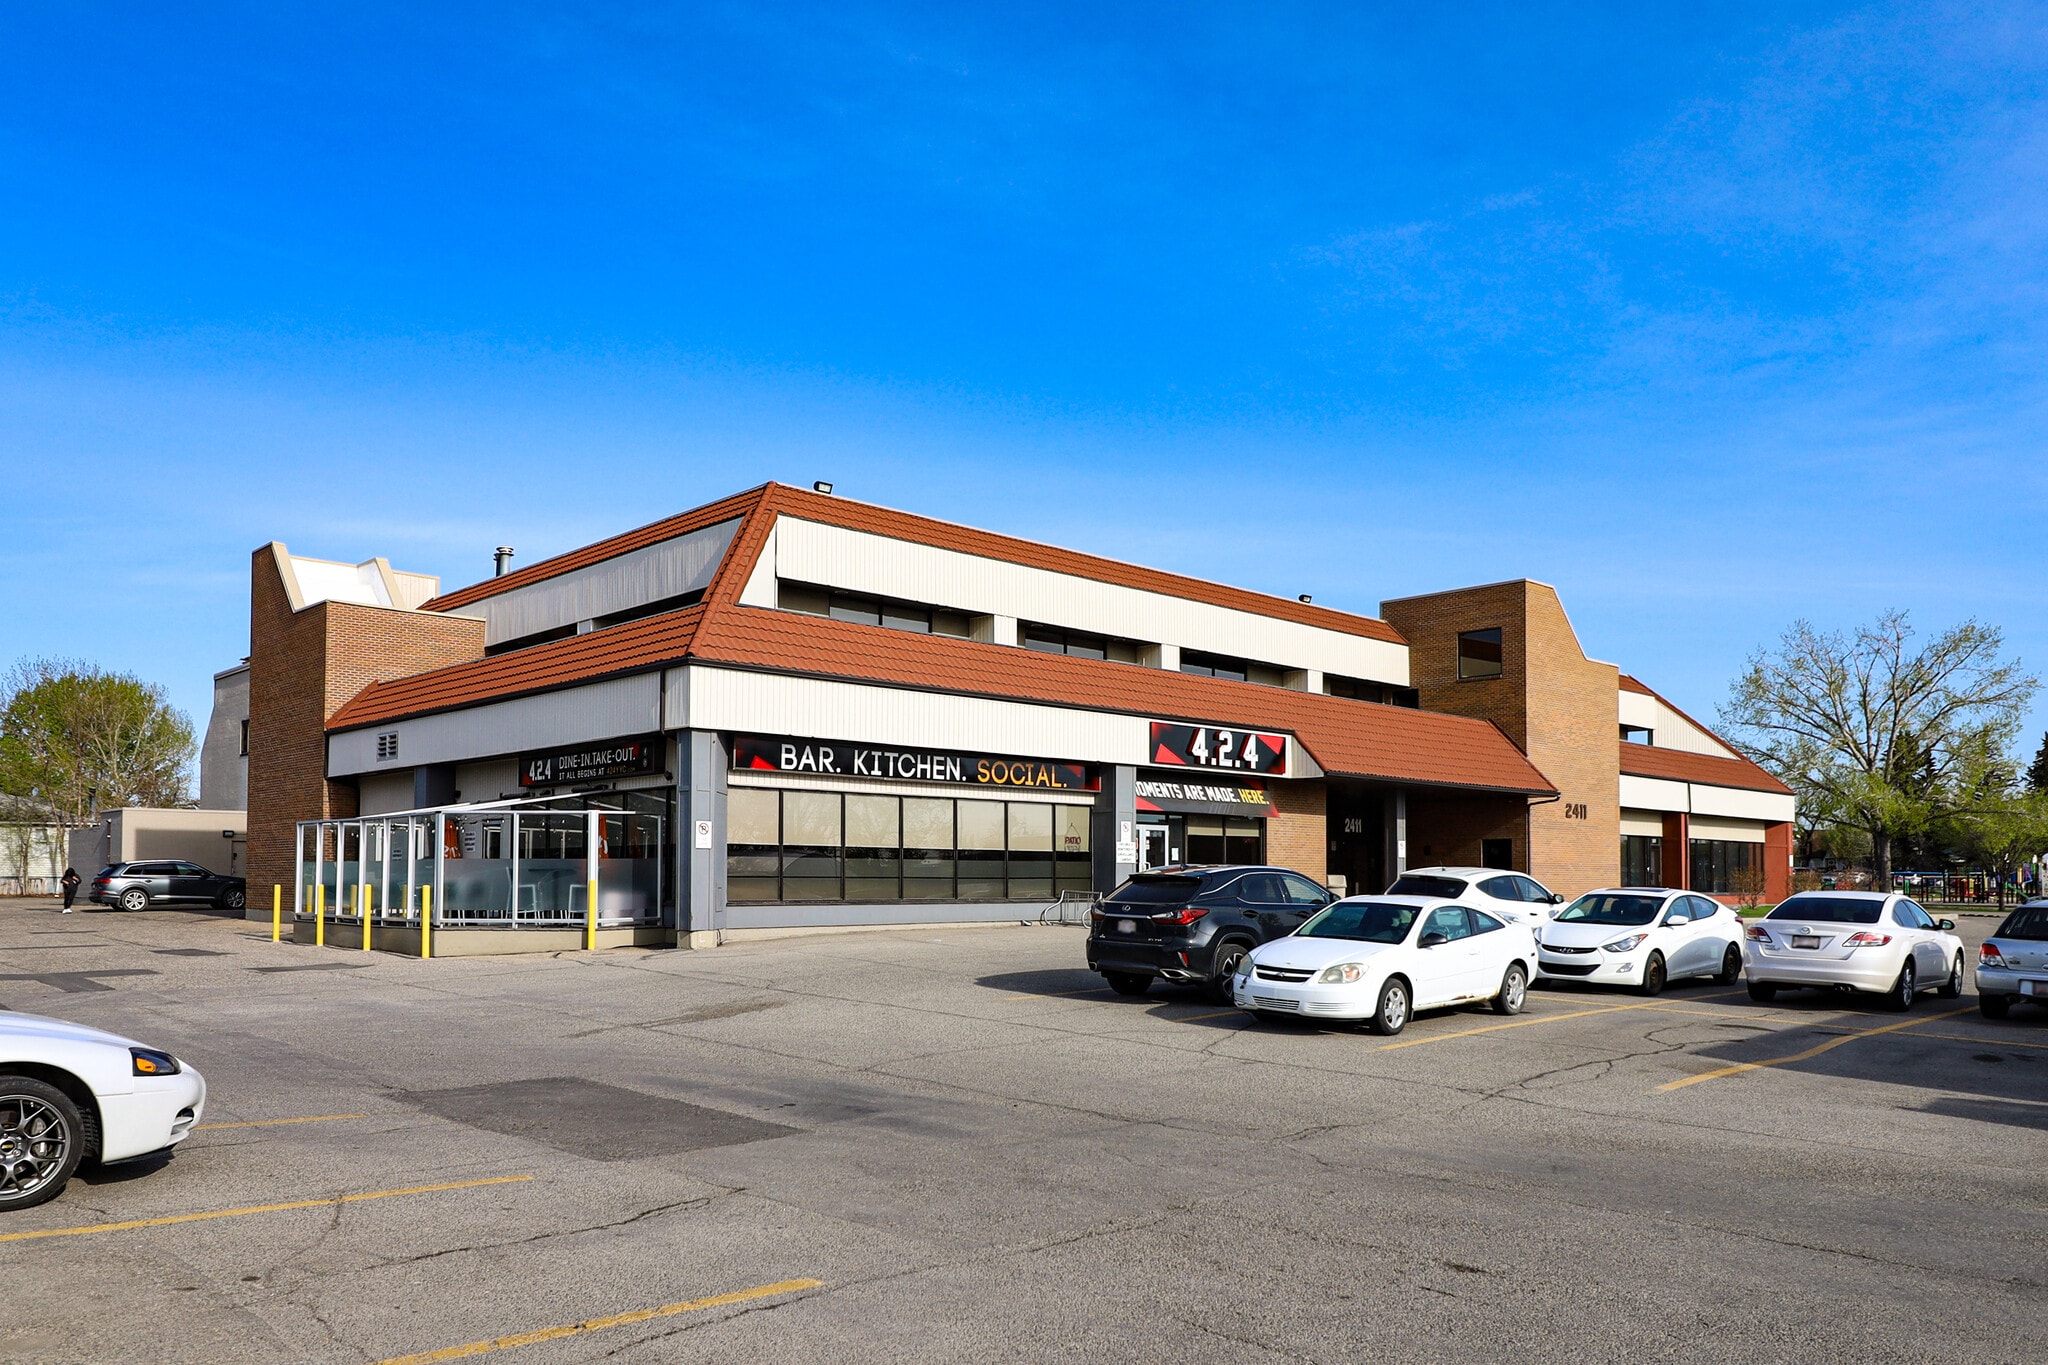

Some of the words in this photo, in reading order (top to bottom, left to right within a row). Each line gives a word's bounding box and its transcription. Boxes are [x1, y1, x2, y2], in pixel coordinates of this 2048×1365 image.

[1191, 728, 1258, 769] 4.2.4
[529, 758, 551, 781] 4.2.4
[559, 772, 565, 780] IT
[566, 770, 576, 780] ALL
[577, 768, 597, 778] BEGINS
[597, 766, 605, 776] AT
[780, 744, 841, 773] BAR.
[853, 750, 966, 782] KITCHEN.
[977, 759, 1068, 788] SOCIAL.
[1136, 781, 1183, 799] OMENTS
[1183, 784, 1207, 800] ARE
[1206, 786, 1240, 803] MADE.
[1238, 788, 1270, 804] HERE.
[1565, 802, 1587, 820] 2411
[1344, 817, 1362, 833] 2411
[1064, 836, 1081, 845] PATIO
